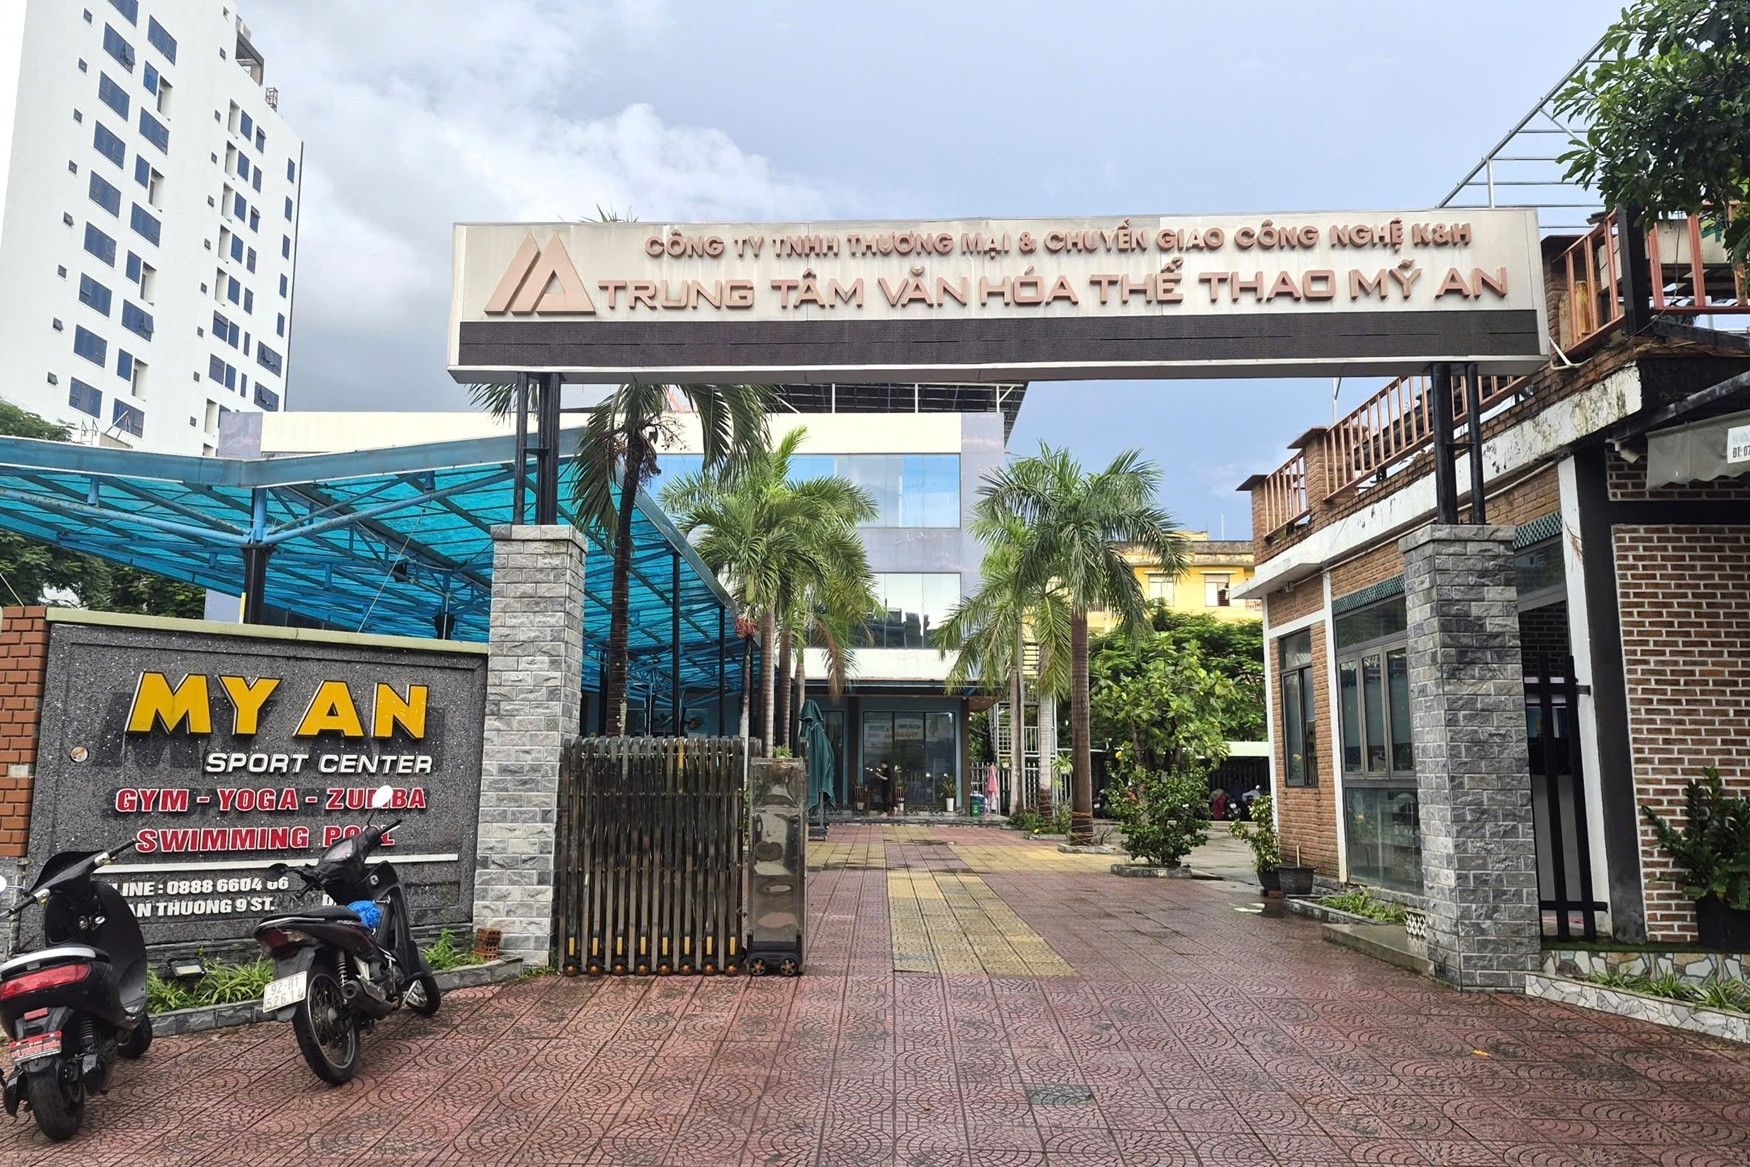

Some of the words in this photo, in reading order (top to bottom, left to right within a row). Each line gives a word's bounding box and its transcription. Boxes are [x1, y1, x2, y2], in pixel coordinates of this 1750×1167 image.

[645, 227, 725, 258] CÔNG
[734, 236, 765, 258] TY
[772, 235, 839, 257] TNHH
[847, 231, 955, 256] THƯƠNG
[961, 232, 1011, 259] MẠI
[1018, 231, 1037, 254] &
[1044, 217, 1148, 253] CHUYỂN
[1156, 226, 1225, 253] GIAO
[1234, 219, 1320, 250] CÔNG
[1330, 217, 1404, 252] NGHỆ
[1411, 222, 1473, 247] K&H
[598, 279, 754, 310] TRUNG
[770, 268, 864, 309] TÂM
[877, 265, 969, 308] VĂN
[979, 265, 1079, 307] HÓA
[1089, 256, 1184, 305] THỂ
[1199, 269, 1336, 303] THAO
[1349, 259, 1423, 300] MỸ
[1435, 266, 1509, 300] AN
[125, 671, 283, 737] MY
[292, 679, 429, 740] AN
[205, 752, 309, 773] SPORT
[318, 753, 432, 775] CENTER
[115, 788, 190, 813] GYM
[216, 788, 299, 811] YOGA
[135, 826, 309, 853] SWIMMING
[166, 880, 213, 895] 0888
[216, 877, 263, 893] 6604
[156, 900, 232, 917] THUONG
[235, 897, 247, 913] 9
[250, 896, 276, 911] ST.
